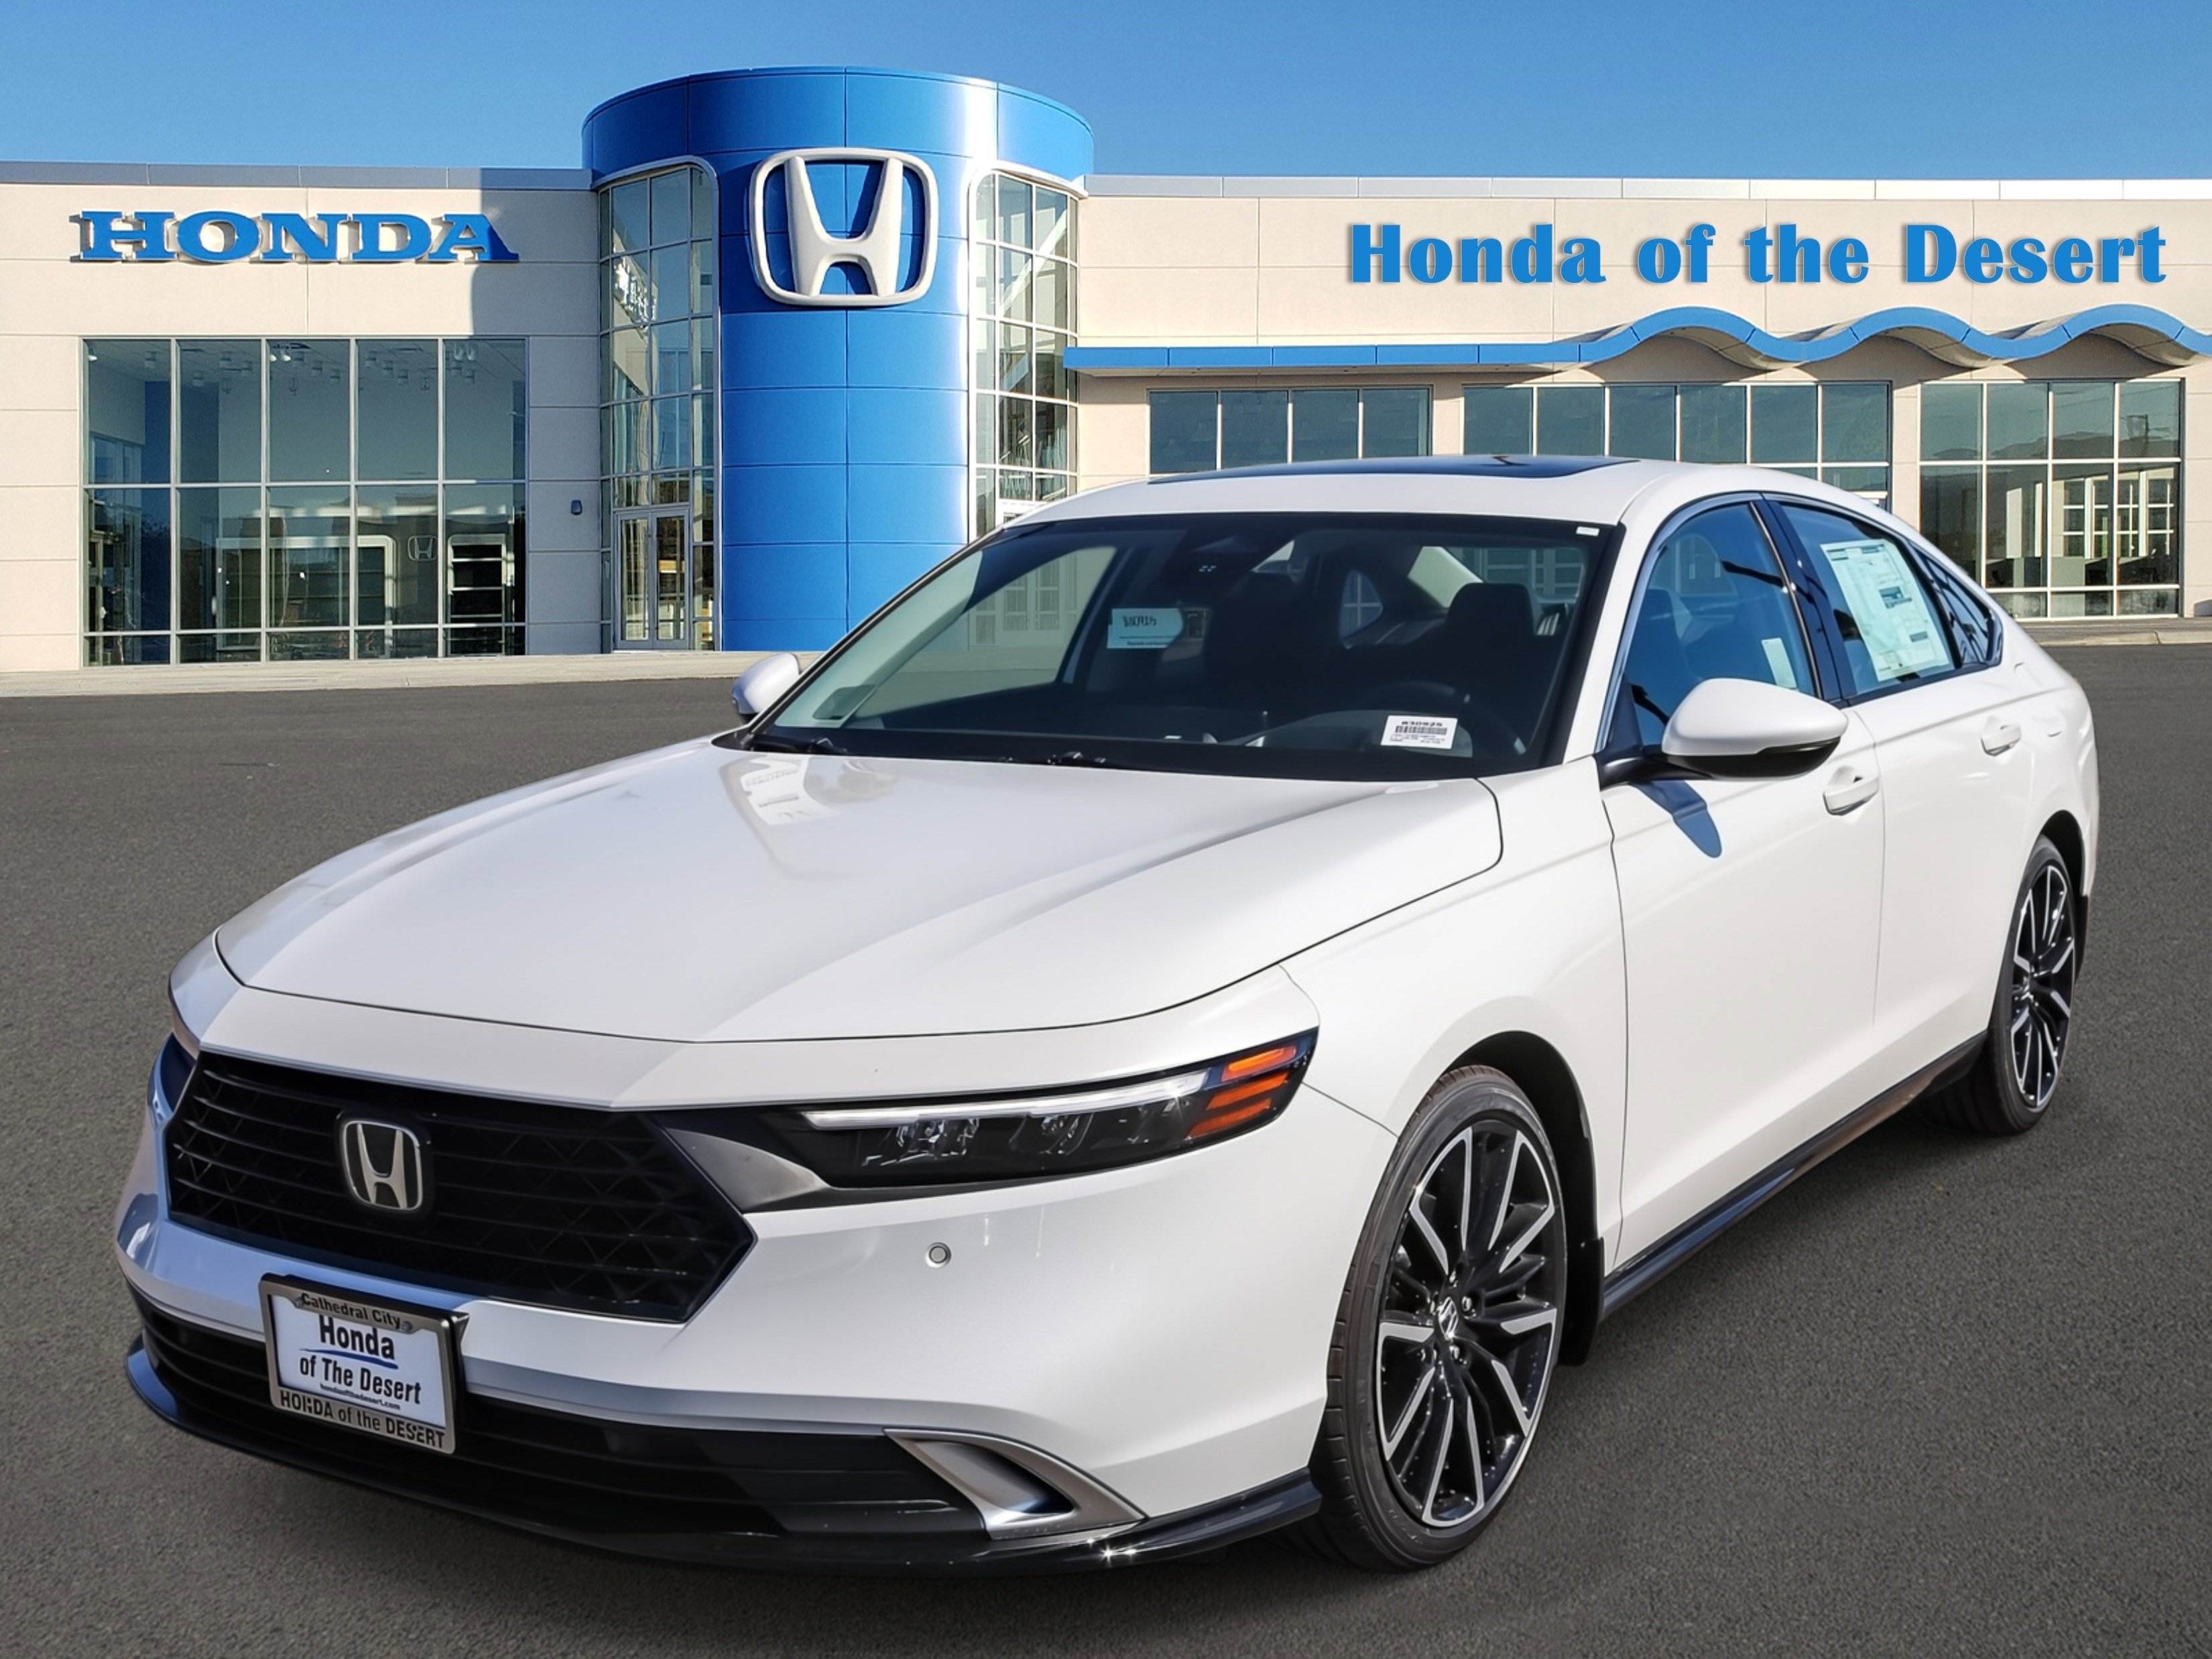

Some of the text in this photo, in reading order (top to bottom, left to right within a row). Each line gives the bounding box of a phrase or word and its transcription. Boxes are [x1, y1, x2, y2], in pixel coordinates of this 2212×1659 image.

[79, 210, 519, 262] HONDA
[1351, 223, 2167, 284] Honda of the Desert
[300, 1292, 402, 1330] Cathedral City
[318, 1315, 395, 1359] Honda
[300, 1355, 422, 1405] of The Desert
[339, 1408, 352, 1423] of
[357, 1409, 381, 1432] the
[386, 1417, 445, 1449] DESERT
